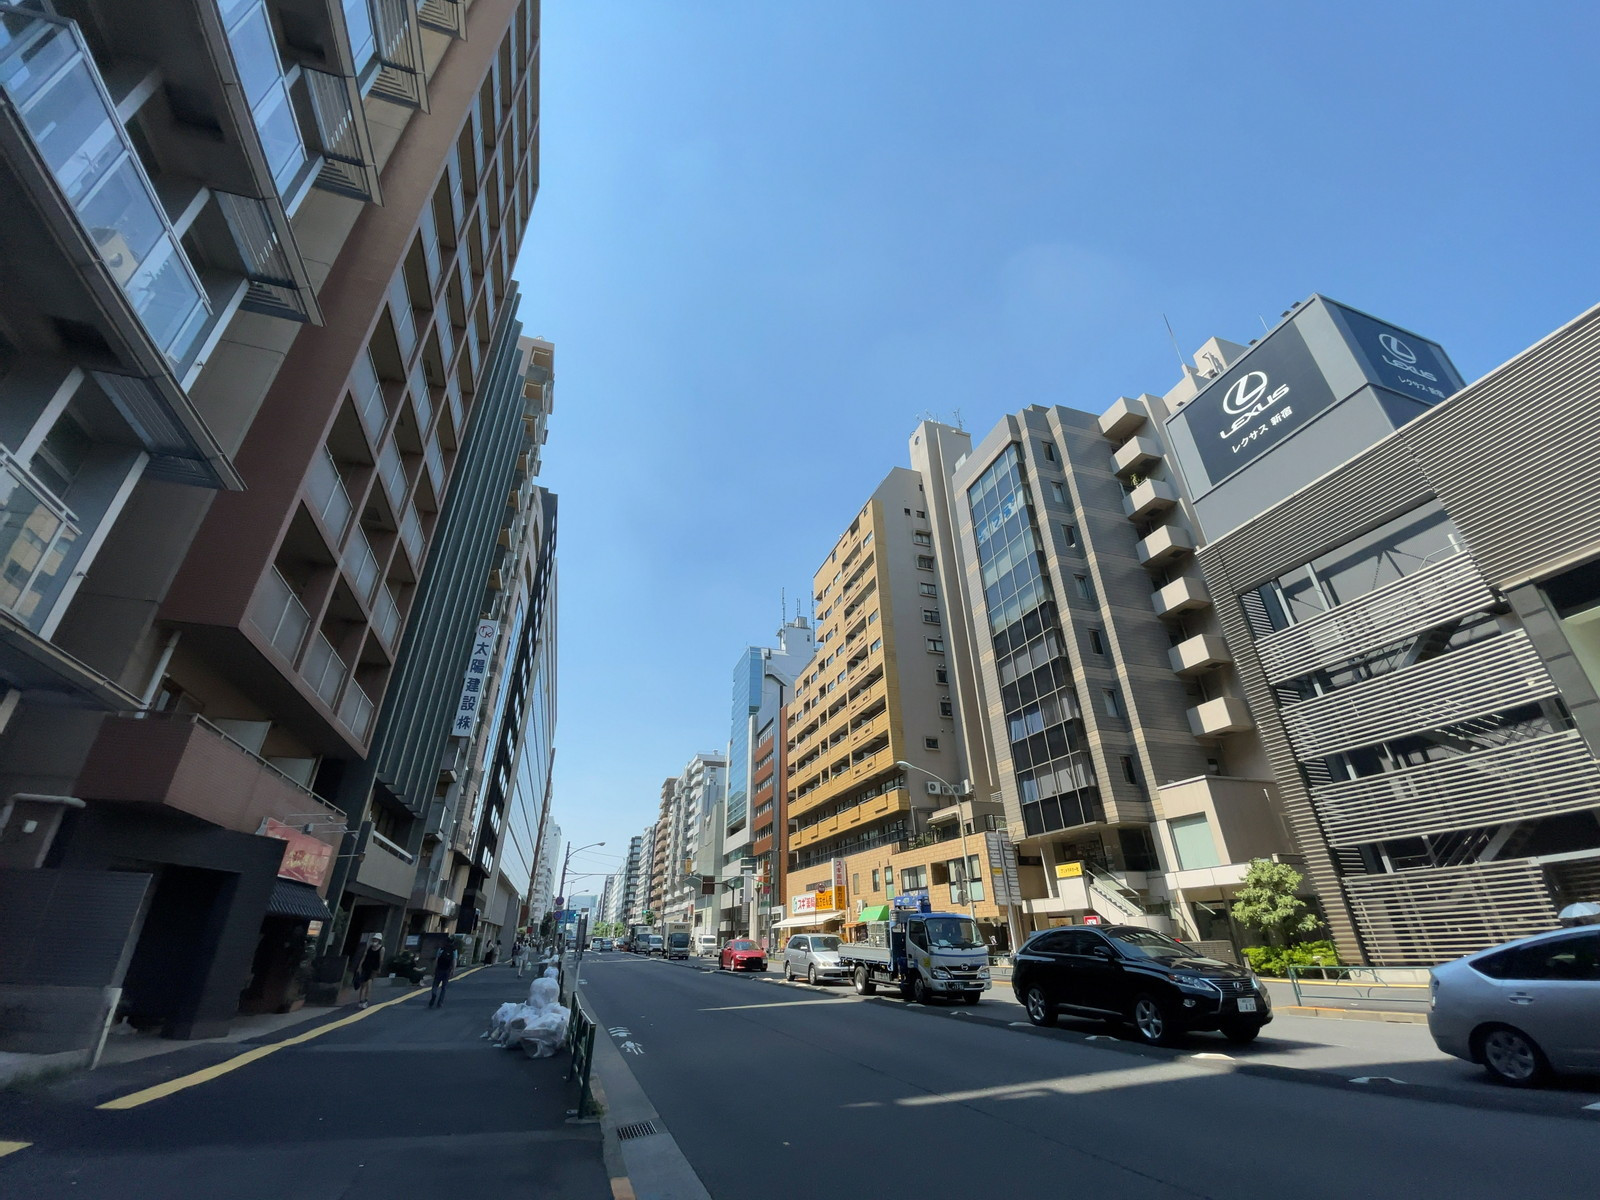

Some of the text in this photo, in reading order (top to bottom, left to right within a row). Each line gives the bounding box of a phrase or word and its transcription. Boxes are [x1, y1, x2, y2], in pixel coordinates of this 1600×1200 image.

[1381, 354, 1438, 382] LEXUS
[1219, 383, 1290, 440] LEXUS
[1231, 405, 1293, 454] レクサス 新宿
